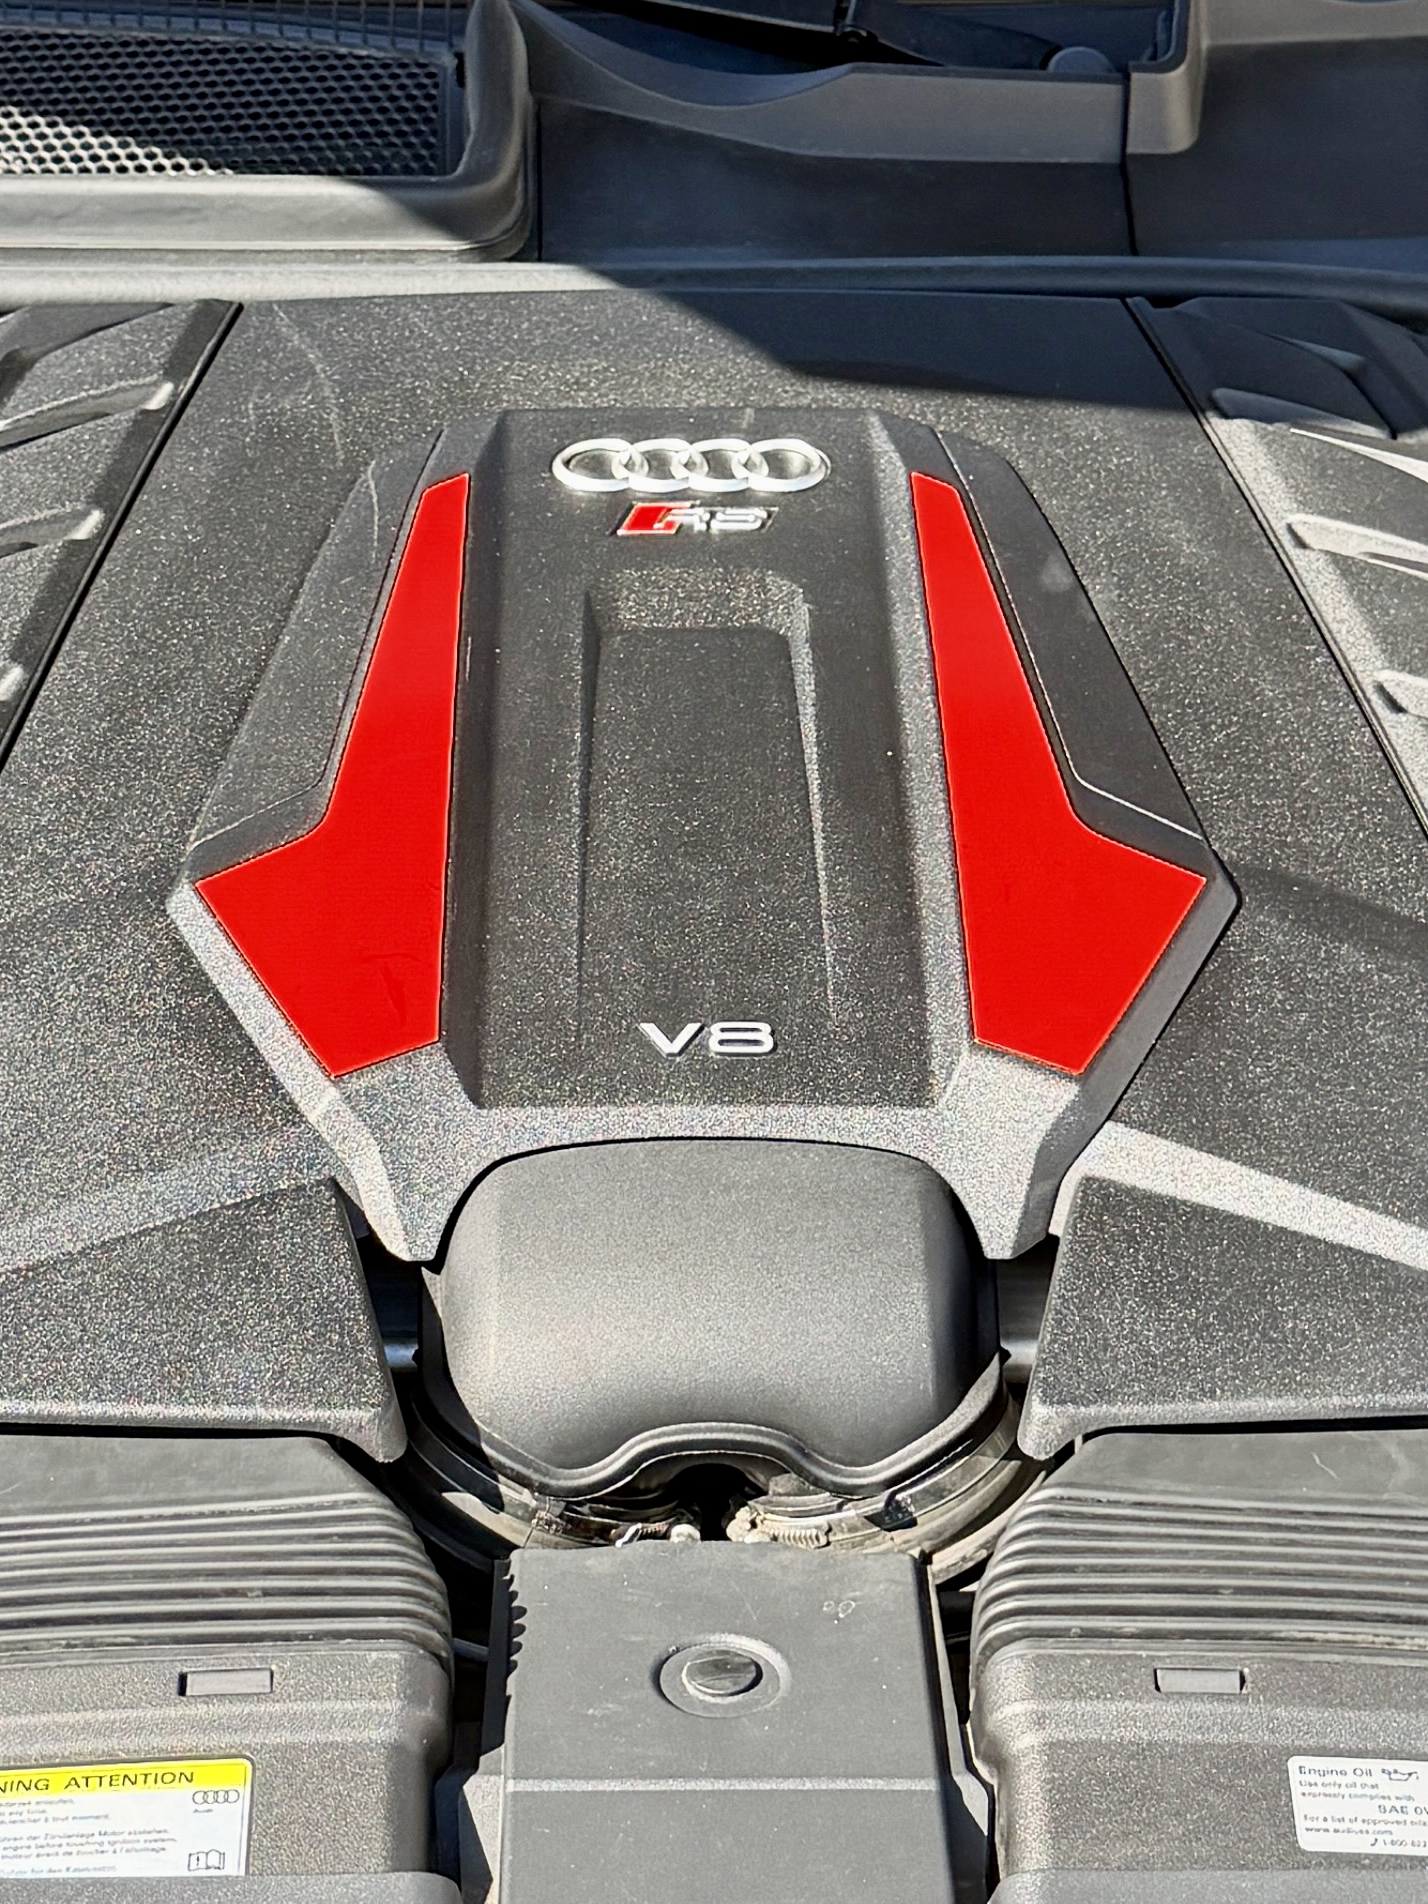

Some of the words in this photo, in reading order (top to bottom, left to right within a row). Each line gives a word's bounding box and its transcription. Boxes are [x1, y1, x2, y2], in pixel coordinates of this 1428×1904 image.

[636, 1021, 776, 1058] V8
[1299, 1766, 1348, 1777] Engine
[1353, 1768, 1372, 1777] Oil
[65, 1769, 194, 1791] ATTENTION
[1378, 1805, 1408, 1814] SAE
